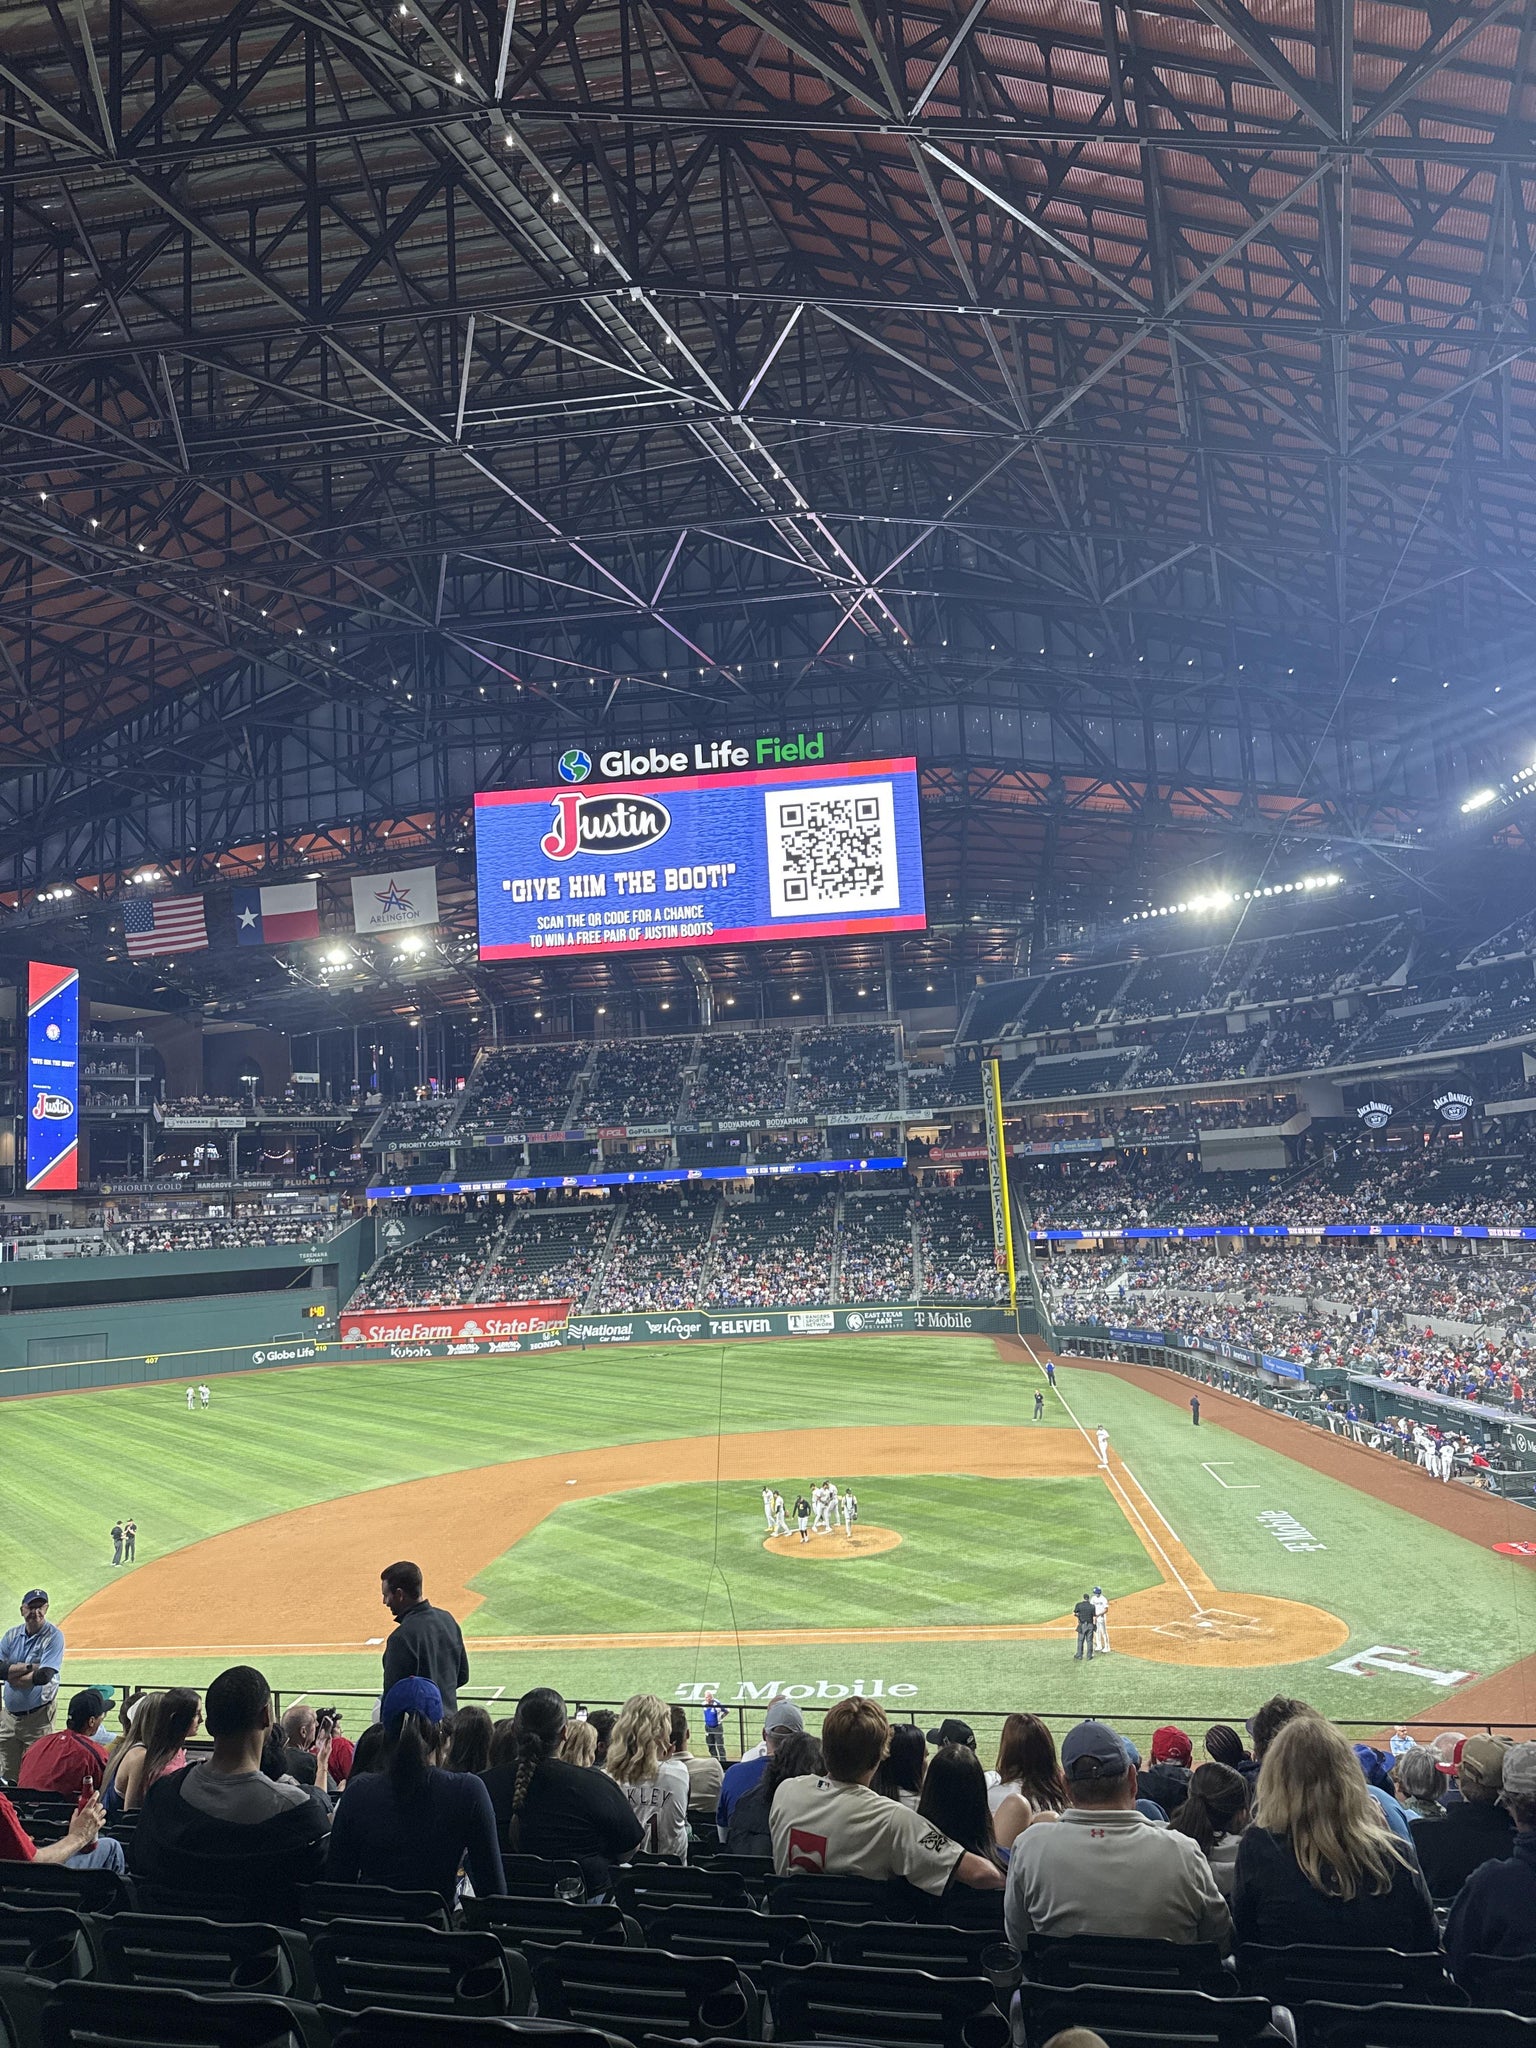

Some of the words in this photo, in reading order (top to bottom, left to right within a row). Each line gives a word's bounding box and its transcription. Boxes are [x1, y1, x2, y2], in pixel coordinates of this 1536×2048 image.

[600, 748, 688, 777] Globe
[694, 740, 750, 770] Life
[756, 732, 825, 764] Field
[543, 796, 659, 859] Justin
[502, 877, 561, 903] "GIVE
[569, 874, 606, 898] HIM
[614, 870, 656, 895] THE
[664, 863, 736, 891] BOOT!"
[370, 910, 420, 924] ARLINGTON
[537, 913, 564, 930] SCAN
[566, 912, 586, 928] THE
[587, 911, 602, 928] QR
[603, 910, 630, 927] CODE
[632, 908, 652, 924] FOR
[654, 907, 662, 922] A
[663, 904, 705, 921] CHANCE
[529, 934, 542, 948] TO
[544, 932, 566, 948] WIN
[567, 931, 575, 946] A
[576, 929, 601, 945] FREE
[603, 927, 627, 943] PAIR
[629, 925, 642, 941] OF
[643, 923, 679, 941] JUSTIN
[680, 921, 714, 938] BOOTS
[33, 1093, 71, 1118] Justin
[1433, 1095, 1448, 1110] JACK
[1447, 1091, 1474, 1106] DANIEL'S
[1357, 1106, 1370, 1118] JACK
[1369, 1101, 1394, 1115] DANIEL'S
[718, 1119, 760, 1130] BODYARMOR
[766, 1117, 808, 1126] BODYARMOR
[399, 1141, 427, 1149] PRIORITY
[428, 1139, 462, 1148] COMMERCE
[503, 1134, 526, 1144] 105.3
[112, 1184, 154, 1193] PRIORITY
[157, 1183, 182, 1191] GOLD
[285, 1178, 331, 1187] PLUCKERS
[663, 1317, 701, 1340] Kroger
[928, 1311, 972, 1329] Mobile
[266, 1351, 295, 1361] Globe
[296, 1347, 315, 1358] Life
[390, 1344, 432, 1358] Kubota
[530, 1340, 562, 1351] HONDA
[736, 1679, 919, 1700] Mobile
